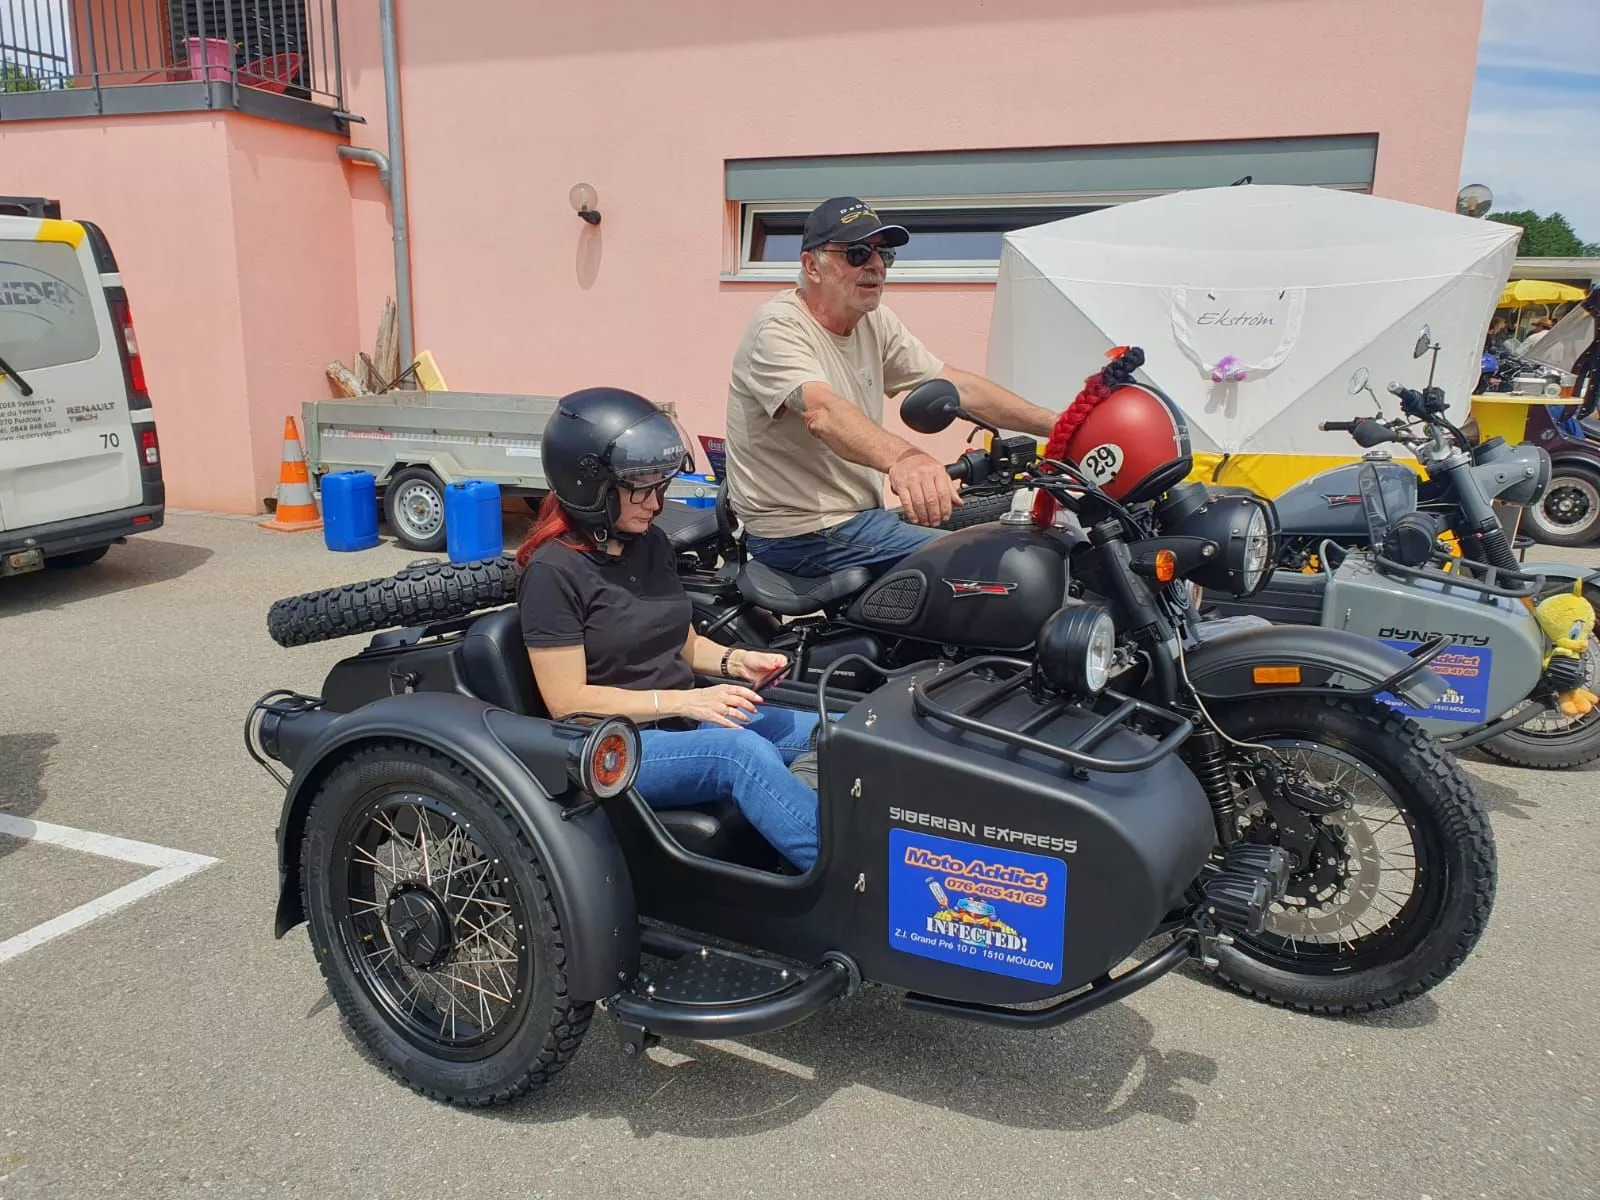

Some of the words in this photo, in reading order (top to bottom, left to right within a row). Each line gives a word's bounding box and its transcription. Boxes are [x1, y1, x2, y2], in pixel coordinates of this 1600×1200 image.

[0, 281, 74, 305] IEDER
[66, 401, 116, 415] RENAULT
[99, 432, 120, 450] 70
[1086, 446, 1117, 478] 29
[889, 806, 976, 837] SIBERIAN
[983, 826, 1078, 854] EXPRESS
[905, 846, 965, 875] Moto
[965, 860, 1048, 891] Addict
[945, 877, 975, 893] 076
[974, 882, 1003, 898] 465
[1003, 887, 1024, 904] 41
[1023, 892, 1047, 909] 65
[926, 916, 1028, 953] INFECTED!
[910, 932, 937, 946] Grand
[956, 943, 968, 953] 10
[969, 946, 977, 955] D
[982, 949, 1004, 961] 1510
[1006, 954, 1054, 972] MOUDON
